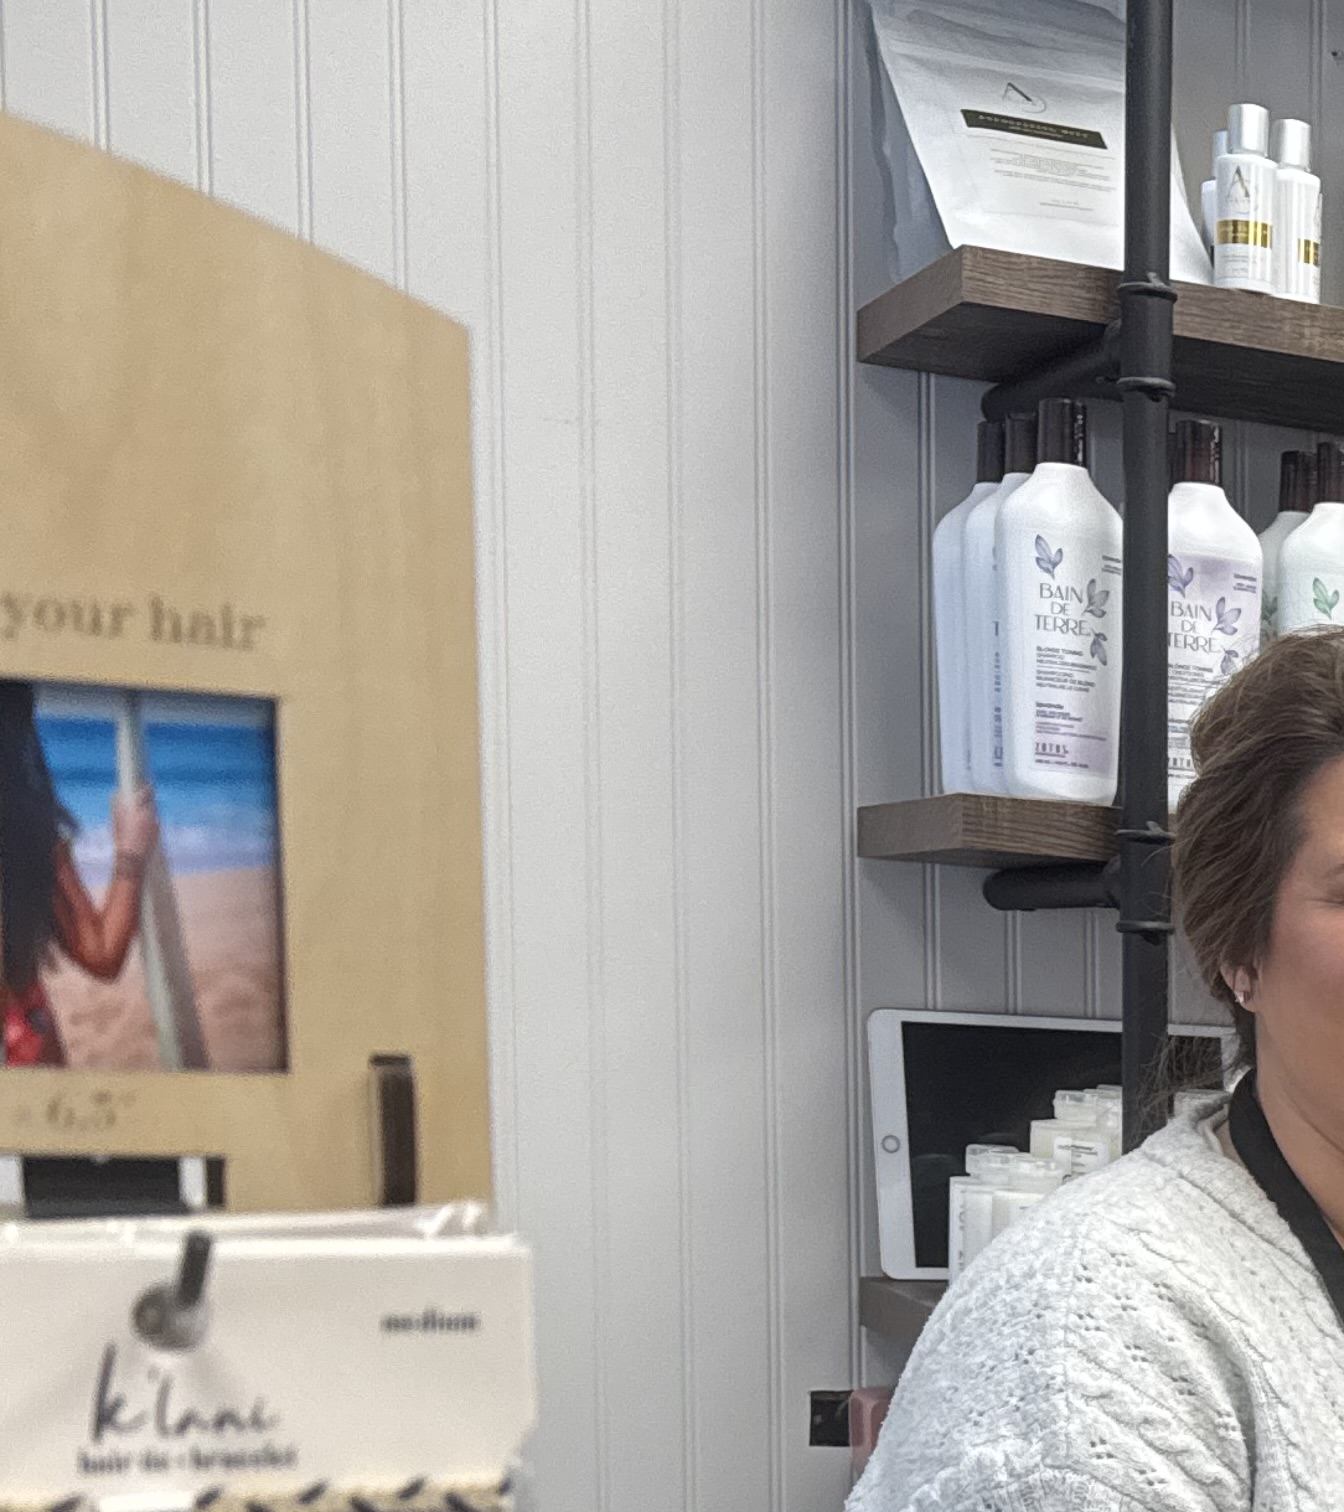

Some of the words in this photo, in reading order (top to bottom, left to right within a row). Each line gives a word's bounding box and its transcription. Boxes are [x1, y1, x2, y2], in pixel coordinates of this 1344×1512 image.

[1039, 582, 1084, 604] BAIN
[1050, 601, 1071, 616] DE
[1170, 600, 1213, 622] BAIN
[149, 591, 267, 651] hair
[1035, 613, 1091, 637] TERRE
